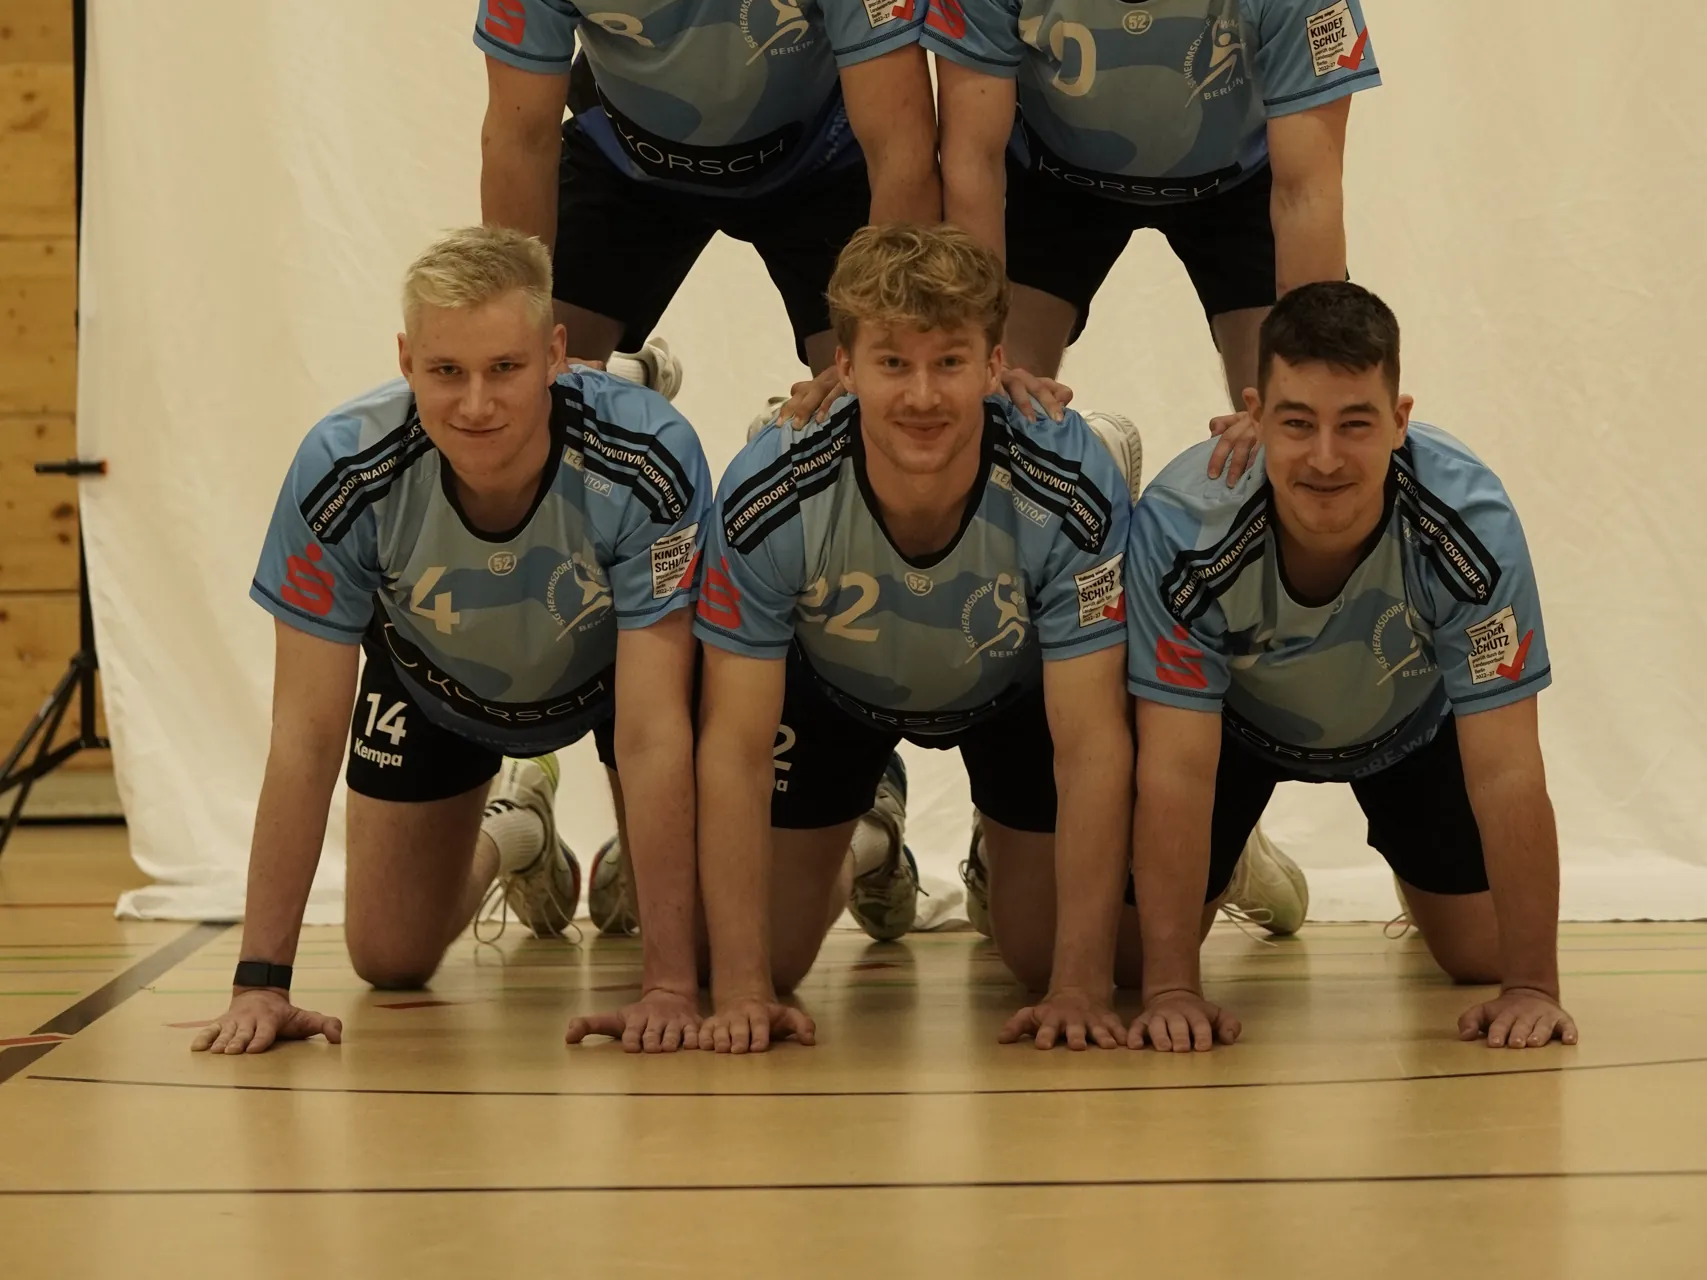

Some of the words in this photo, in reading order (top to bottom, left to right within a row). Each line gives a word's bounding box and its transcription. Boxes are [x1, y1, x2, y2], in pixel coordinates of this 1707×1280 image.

[1128, 14, 1147, 29] 52
[744, 35, 758, 49] SG
[1184, 18, 1211, 79] HERMSDF
[1313, 27, 1347, 50] SCHUTZ
[616, 122, 784, 175] KORSCH
[1039, 156, 1219, 197] KORSCH
[493, 557, 512, 572] 52
[547, 559, 573, 612] HERMSDORF
[908, 575, 926, 592] 52
[388, 567, 460, 634] 4
[961, 581, 994, 633] HERMSDORF
[552, 613, 566, 627] SG
[1372, 602, 1406, 654] HERMSDORF
[965, 635, 979, 648] SG
[1470, 635, 1510, 657] SCHUTZ
[1377, 656, 1391, 669] SG
[366, 692, 408, 746] 14
[353, 736, 404, 768] Kempa
